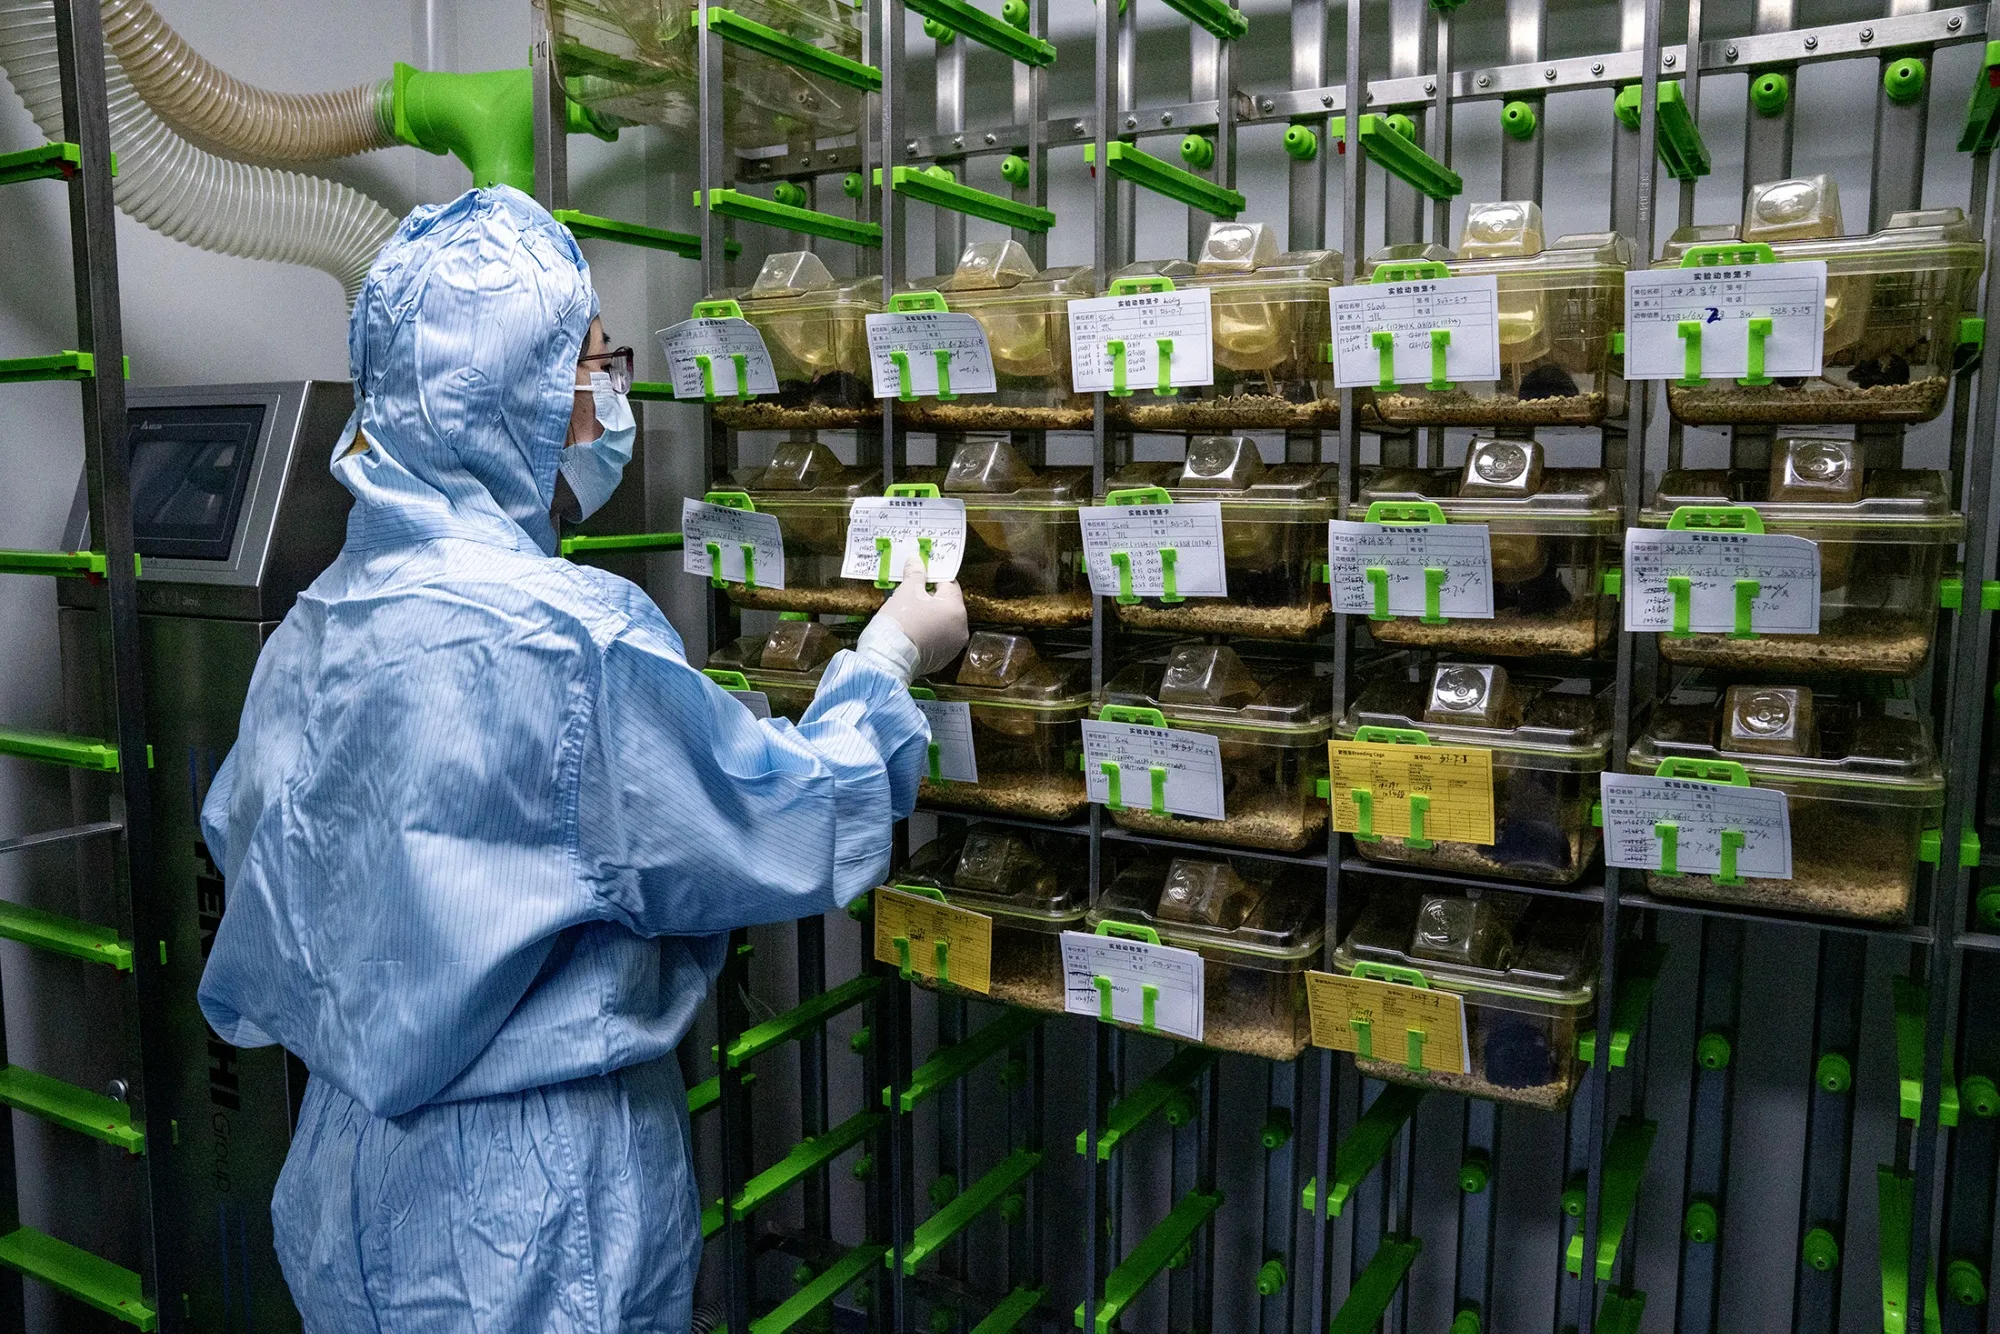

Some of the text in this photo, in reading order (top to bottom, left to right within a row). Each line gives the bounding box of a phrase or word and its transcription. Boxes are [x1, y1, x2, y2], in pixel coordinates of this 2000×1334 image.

[1694, 270, 1752, 281] 实验动物笼卡
[1388, 285, 1437, 295] 实验动物笼卡
[1633, 287, 1660, 296] 单位名称
[1118, 298, 1159, 307] 实验动物笼卡
[1338, 302, 1360, 310] 单位名称
[1633, 299, 1660, 307] 联系人
[1338, 313, 1361, 321] 联系人
[1633, 311, 1660, 319] 动物信息
[1128, 508, 1170, 516] 实验动物笼卡
[1692, 534, 1748, 543] 实验动物笼卡
[1129, 728, 1169, 737] 实验动物笼卡
[1664, 781, 1718, 792] 实验动物笼卡
[1109, 943, 1149, 954] 实验动物笼卡
